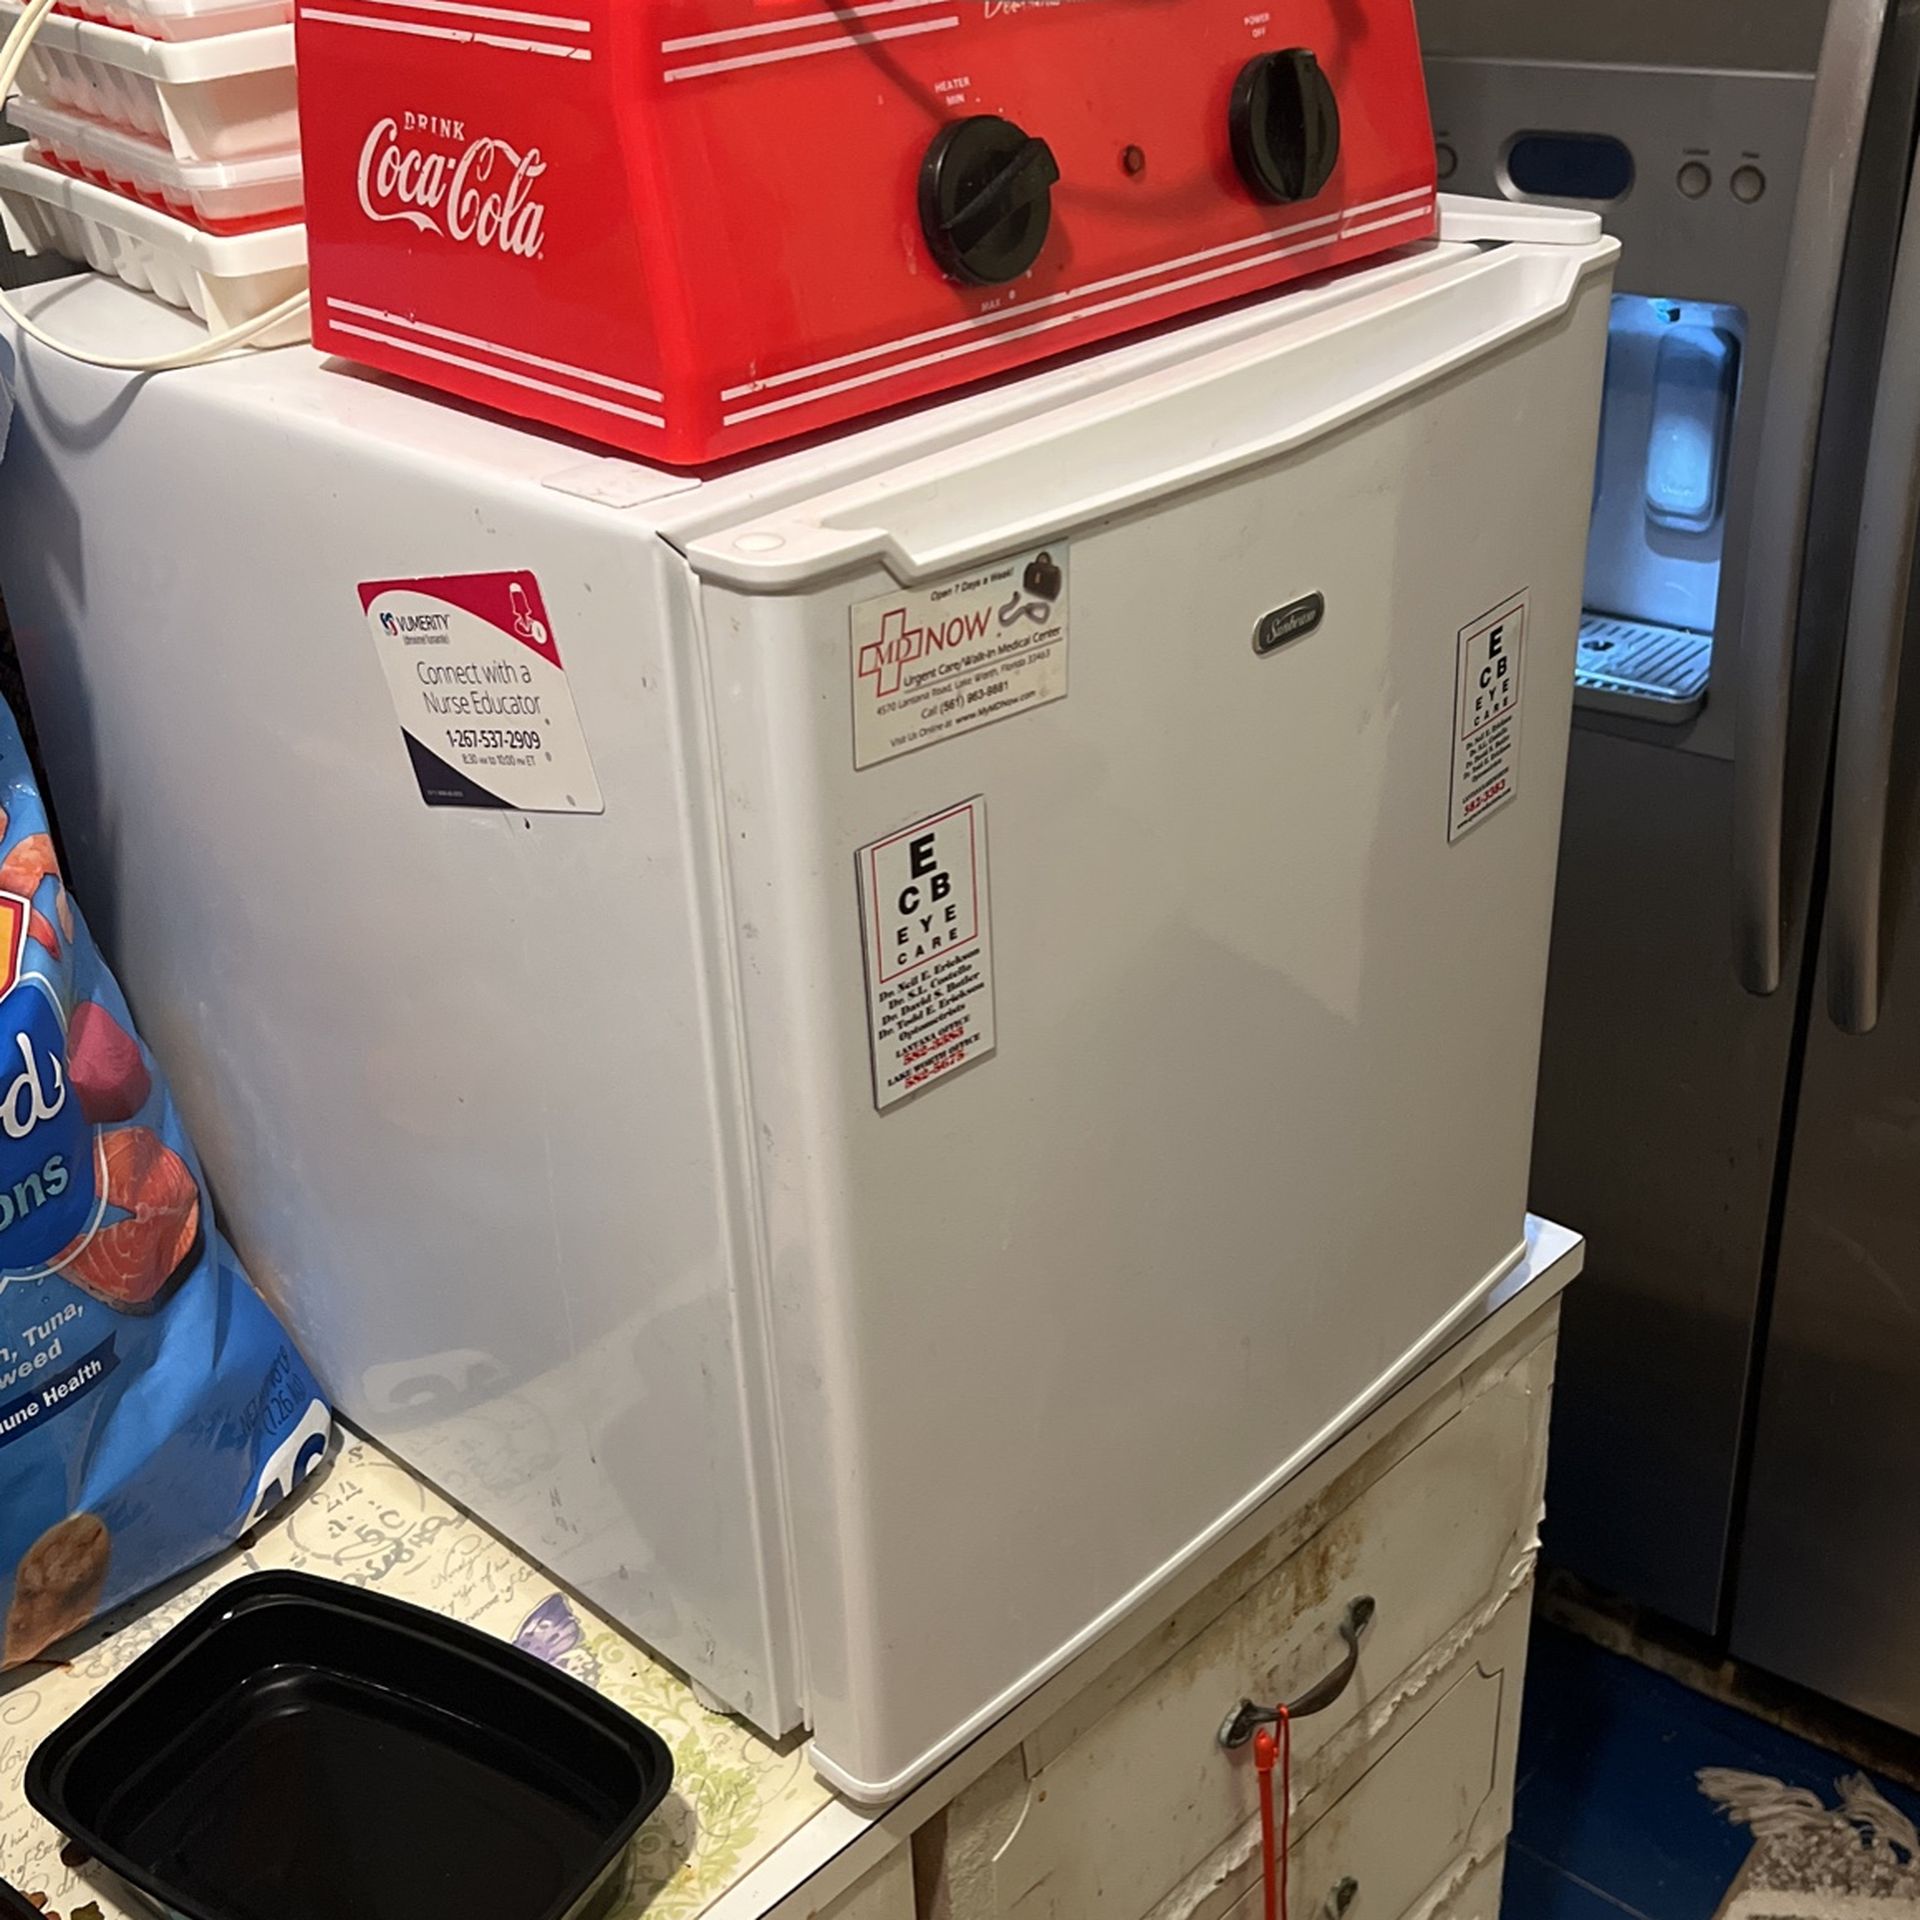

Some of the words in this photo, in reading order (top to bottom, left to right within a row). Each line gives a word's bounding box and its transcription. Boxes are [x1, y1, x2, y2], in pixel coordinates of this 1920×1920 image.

[934, 76, 971, 93] HEATER
[404, 111, 464, 142] DRINK
[357, 117, 547, 258] Coca-Cola
[930, 587, 954, 602] Open
[954, 584, 960, 594] 7
[961, 578, 981, 594] Days
[396, 614, 451, 632] VUMERITY
[874, 638, 912, 667] MD
[926, 606, 992, 656] NOW
[903, 668, 937, 688] Urgent
[997, 635, 1031, 655] Medical
[1031, 626, 1062, 644] Center
[1489, 625, 1504, 660] E
[417, 660, 480, 686] Connect
[484, 659, 517, 686] with
[520, 665, 532, 684] a
[422, 691, 470, 715] Nurse
[471, 691, 541, 716] Educator
[920, 703, 939, 720] Call
[939, 692, 965, 715] (561)
[446, 729, 541, 750] 1-267-537-2909
[909, 832, 937, 880] E
[22, 1303, 84, 1347] Tuna,
[42, 1359, 103, 1408] Health
